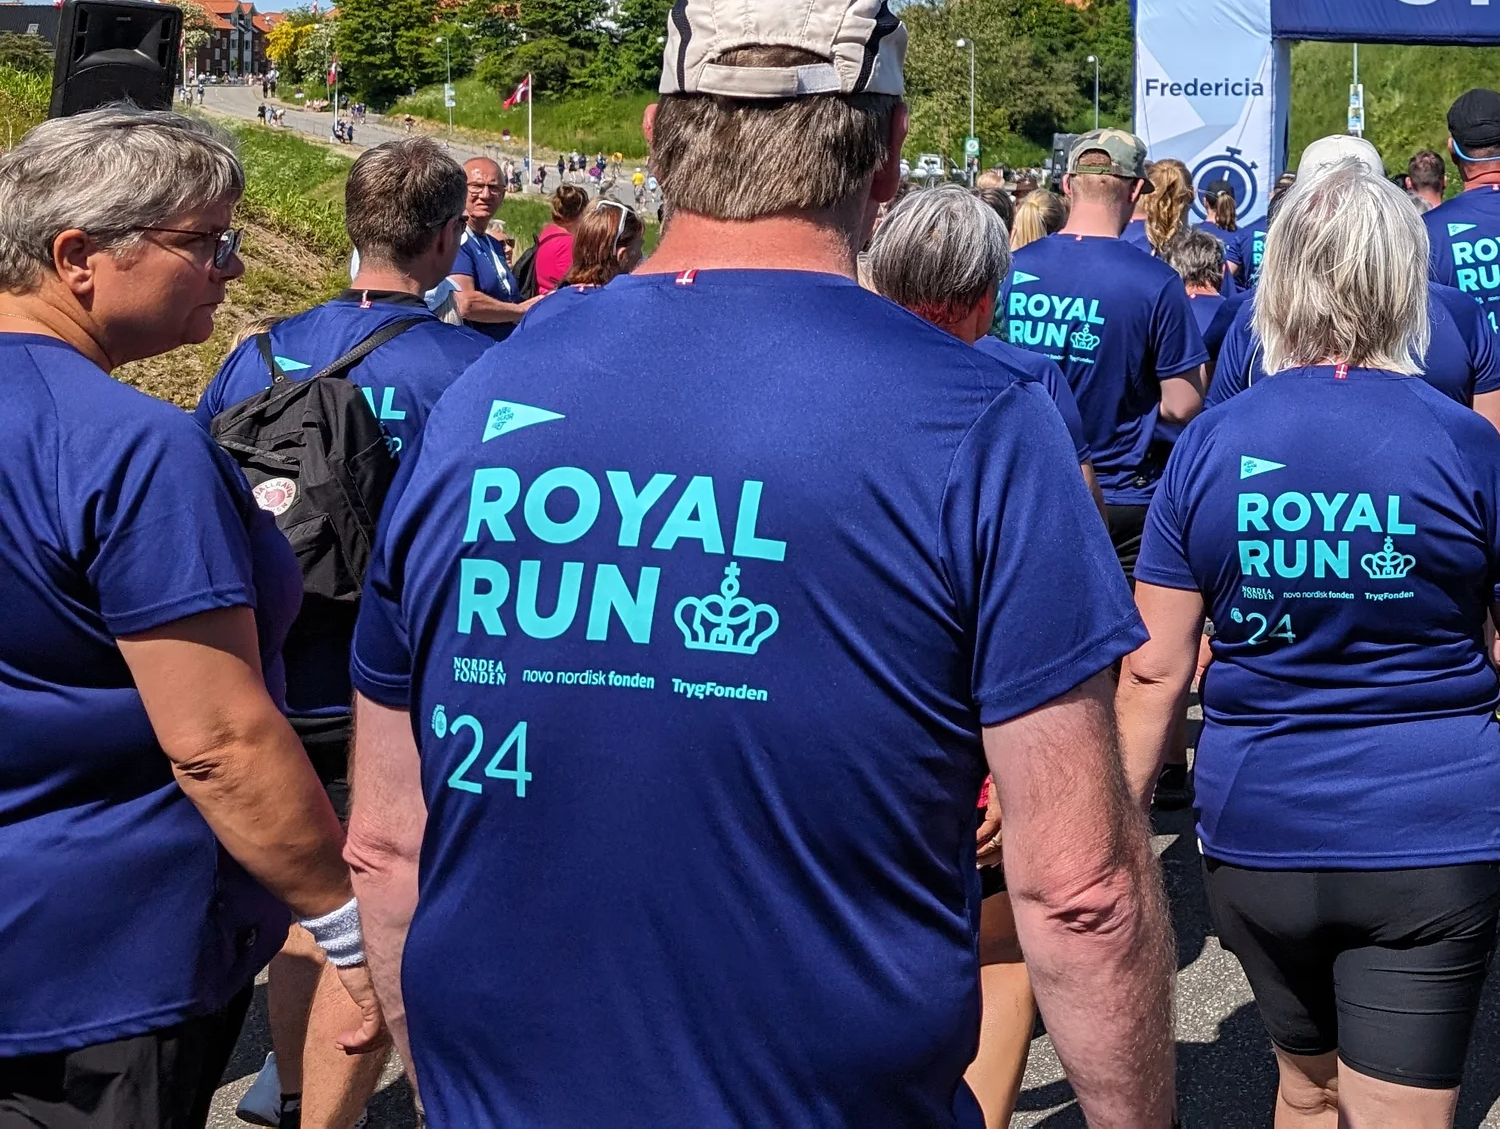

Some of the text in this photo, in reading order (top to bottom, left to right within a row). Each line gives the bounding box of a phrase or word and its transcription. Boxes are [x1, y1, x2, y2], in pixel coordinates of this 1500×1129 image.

[1145, 77, 1265, 97] Fredericia
[1009, 292, 1105, 325] ROYAL
[1009, 319, 1069, 348] RUN
[463, 466, 788, 562] ROYAL
[1237, 491, 1416, 535] ROYAL
[1237, 539, 1350, 579] RUN
[457, 557, 661, 645] RUN
[1283, 590, 1415, 602] novo nordisk fonden TrygFonden
[453, 656, 505, 673] NORDEA
[454, 668, 507, 686] FONDEN
[522, 669, 769, 702] novo nordisk fonden TrygFonden
